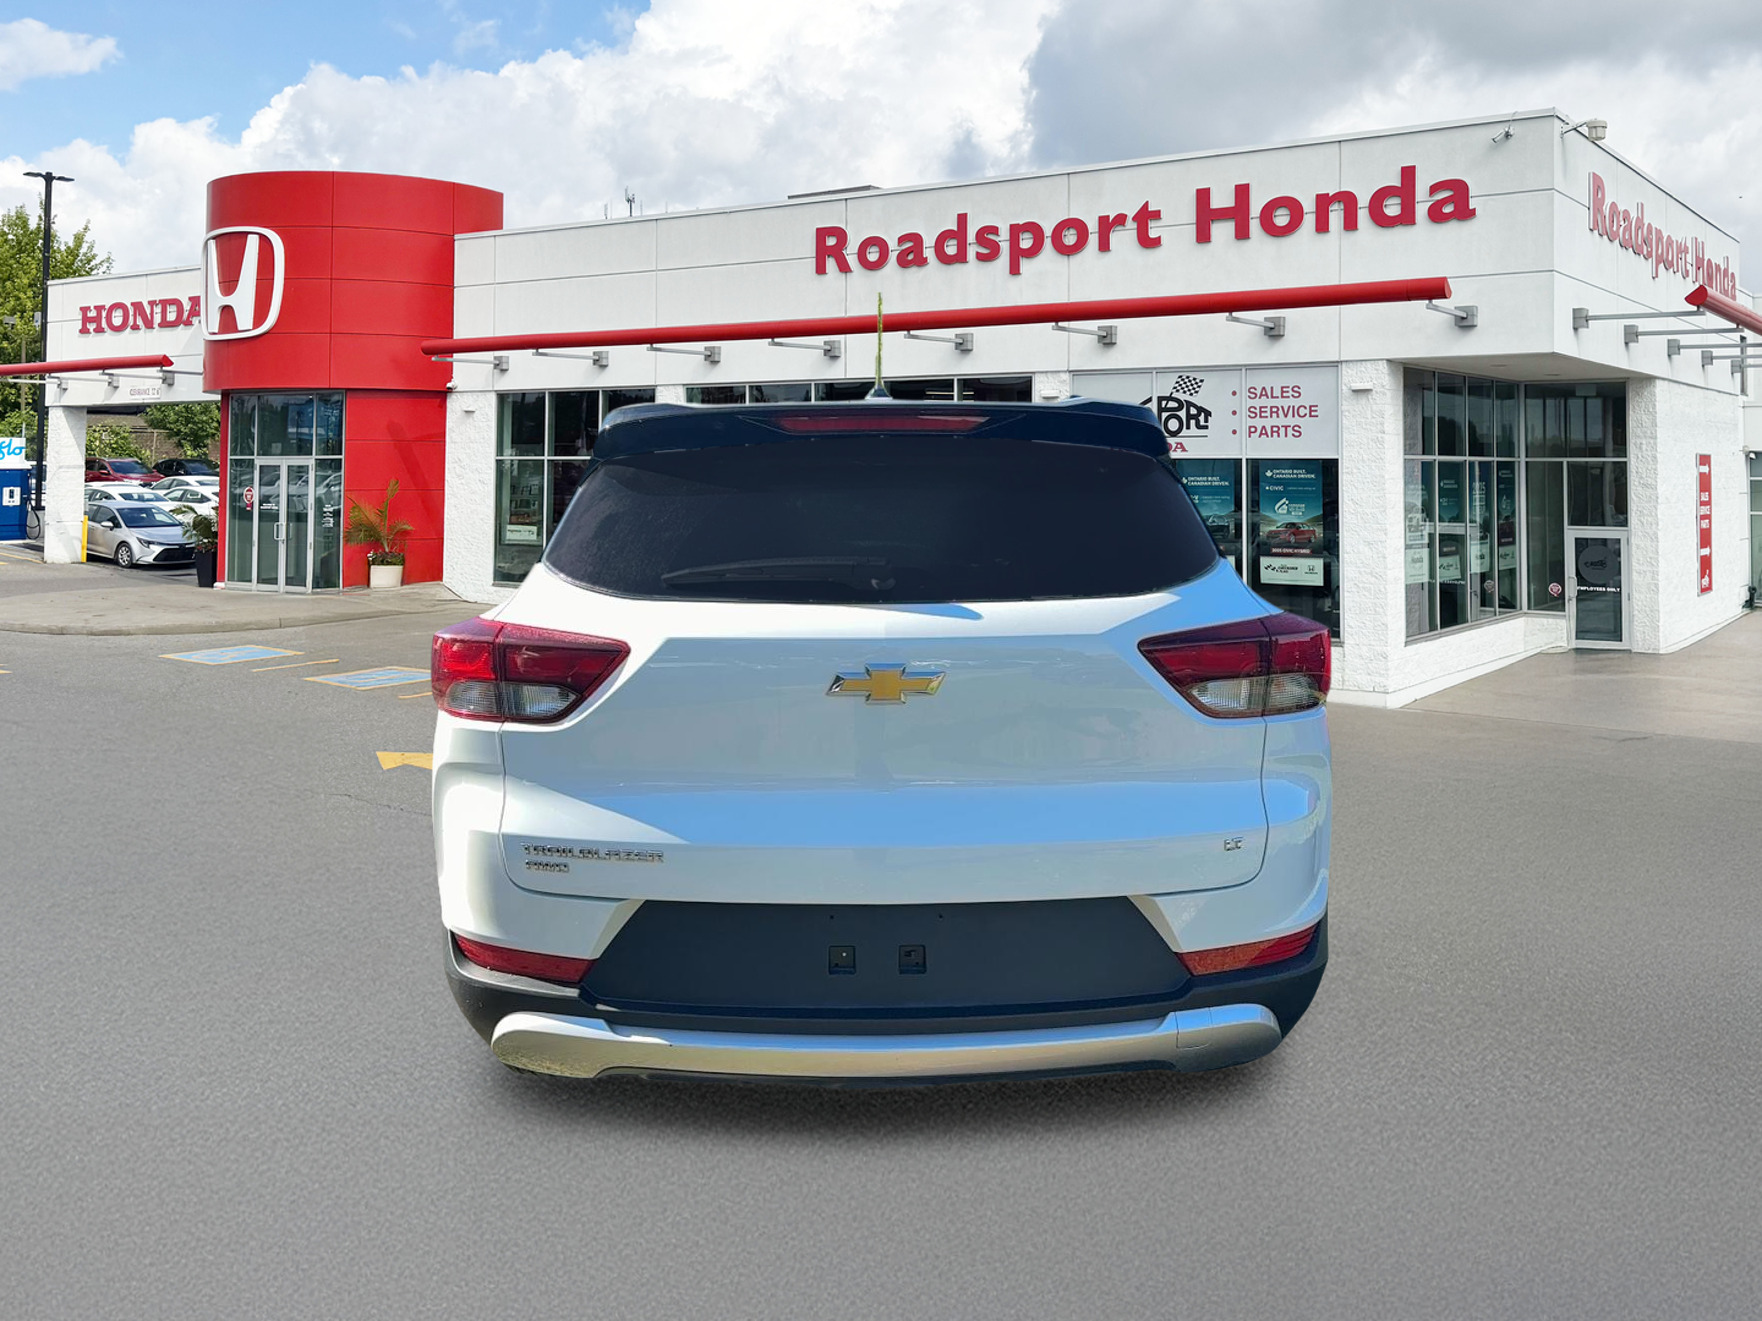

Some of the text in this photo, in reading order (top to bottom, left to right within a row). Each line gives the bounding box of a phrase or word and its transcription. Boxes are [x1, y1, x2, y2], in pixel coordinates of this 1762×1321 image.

[815, 165, 1477, 275] Roadsport Honda
[1588, 172, 1737, 301] Roadsport Honda
[79, 295, 201, 335] HONDA
[1248, 385, 1302, 400] SALES
[1248, 404, 1319, 419] SERVICE
[1248, 424, 1302, 438] PARTS
[521, 843, 664, 863] TRAILBLAZER
